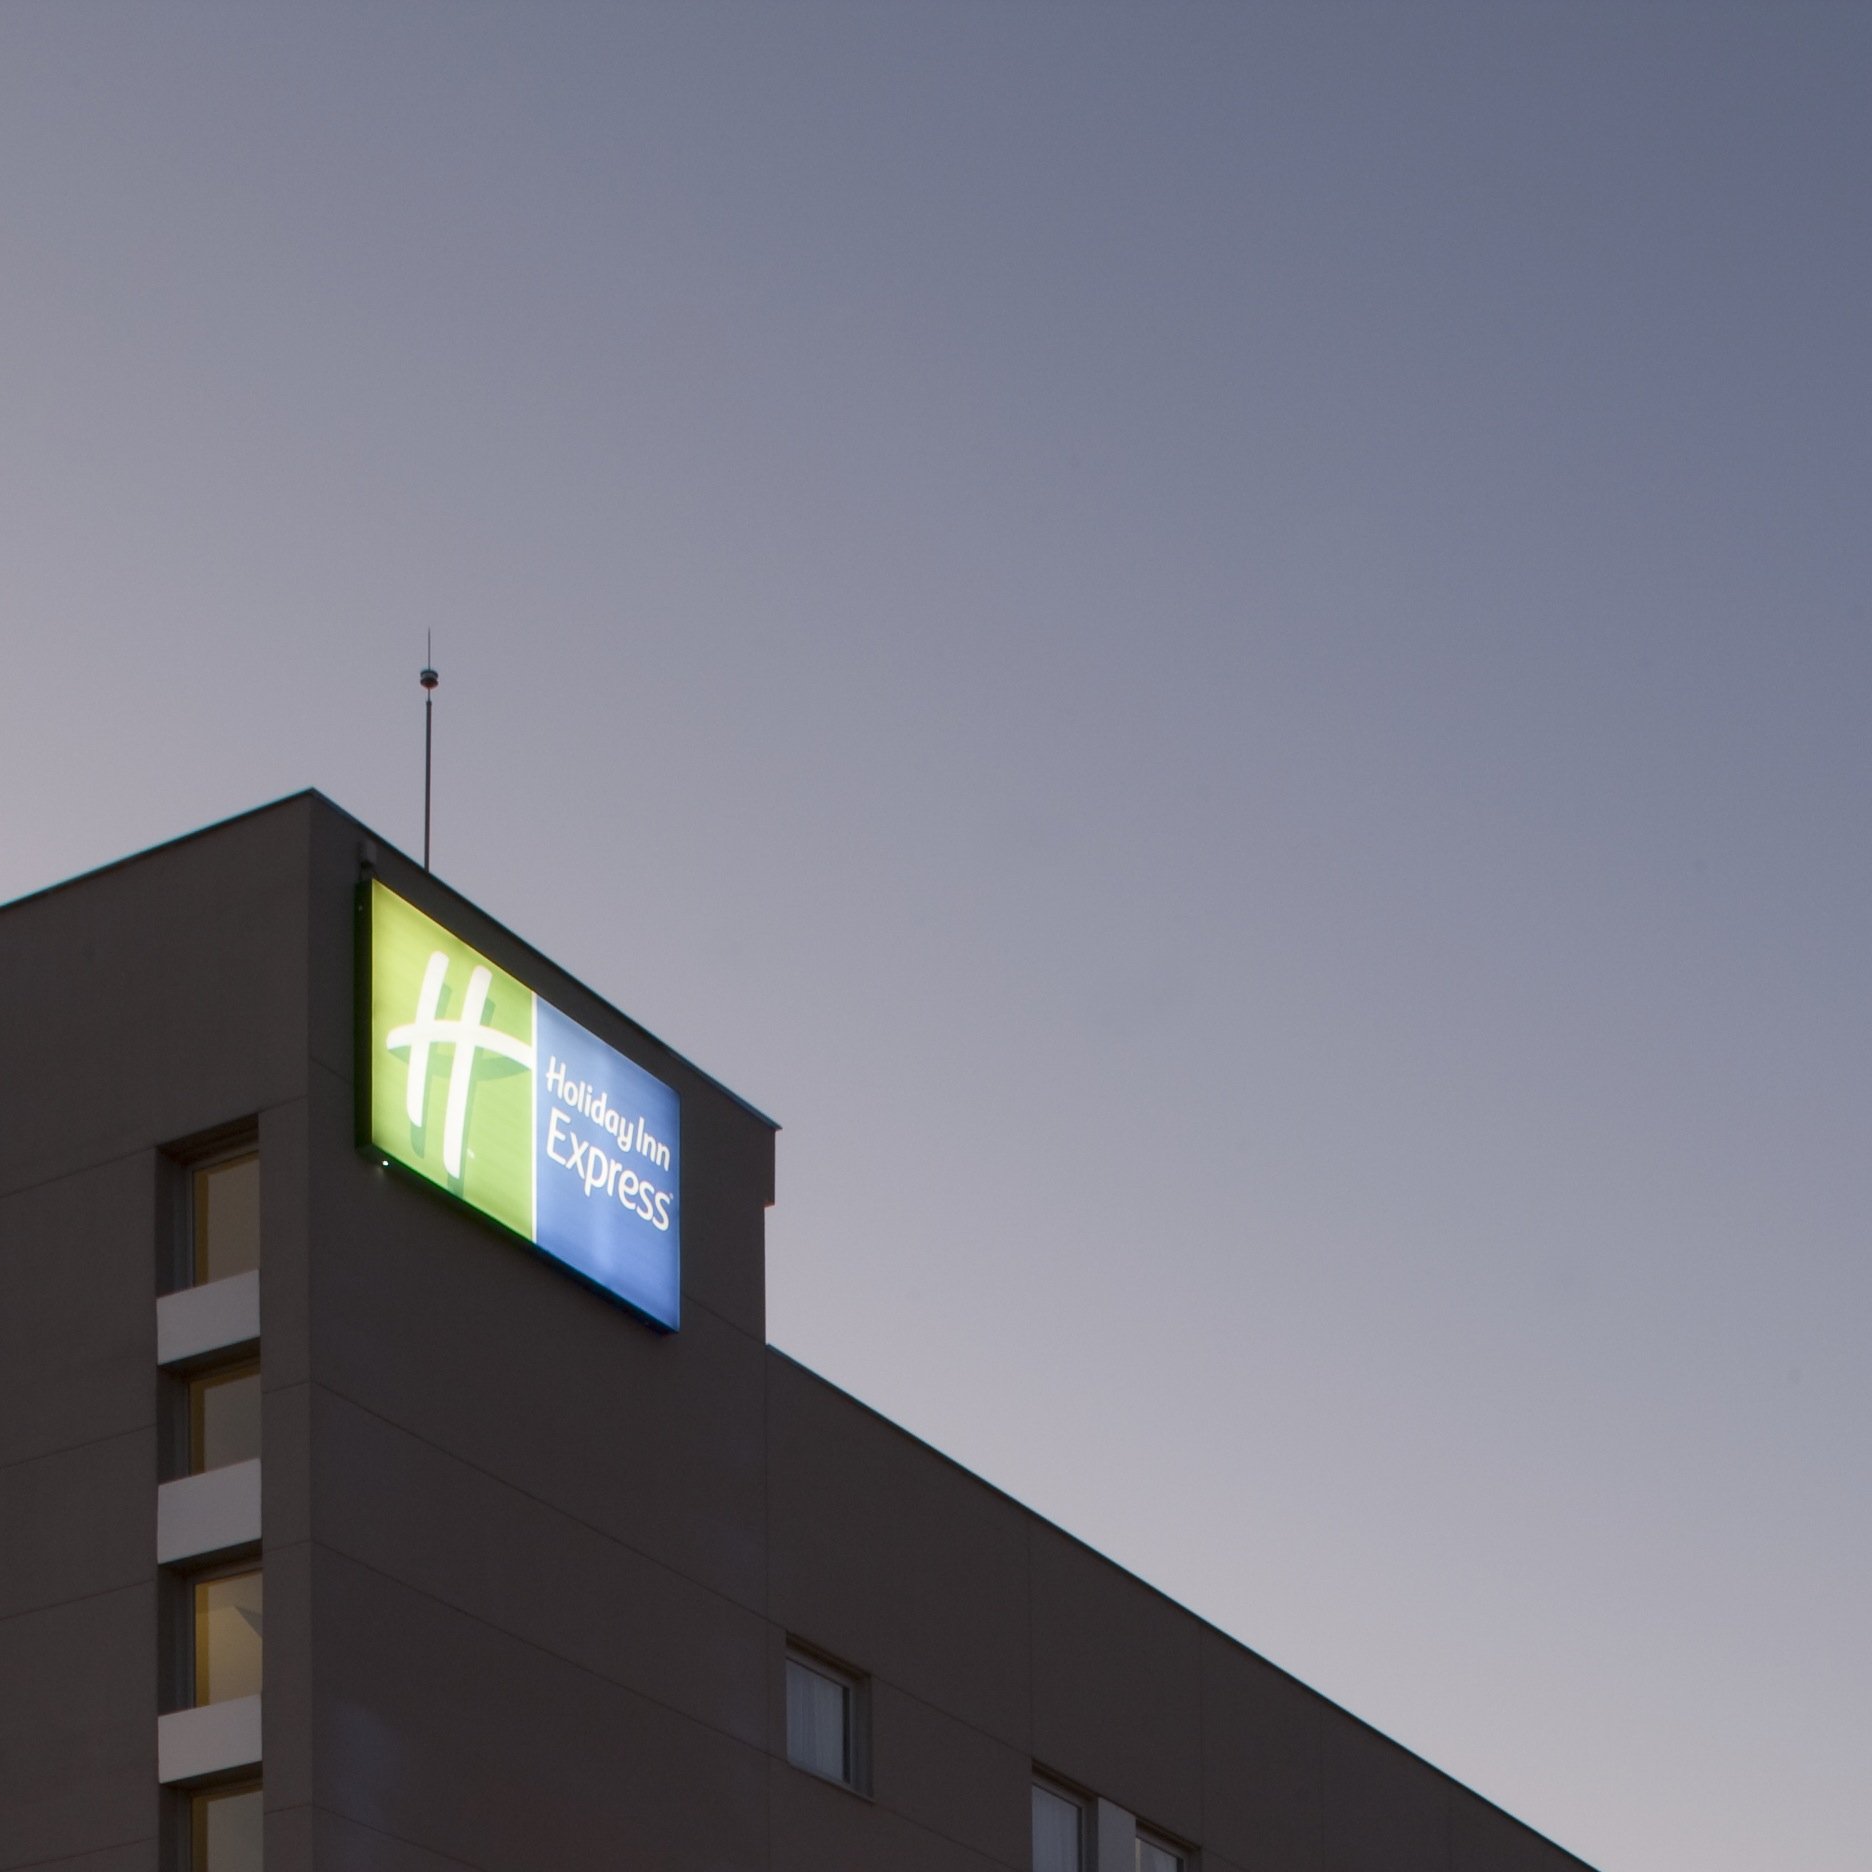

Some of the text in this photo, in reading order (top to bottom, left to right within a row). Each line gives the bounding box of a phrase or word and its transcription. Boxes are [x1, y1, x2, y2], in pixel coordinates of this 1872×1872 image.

[545, 1056, 671, 1172] Holiday Inn
[546, 1107, 671, 1231] Express
